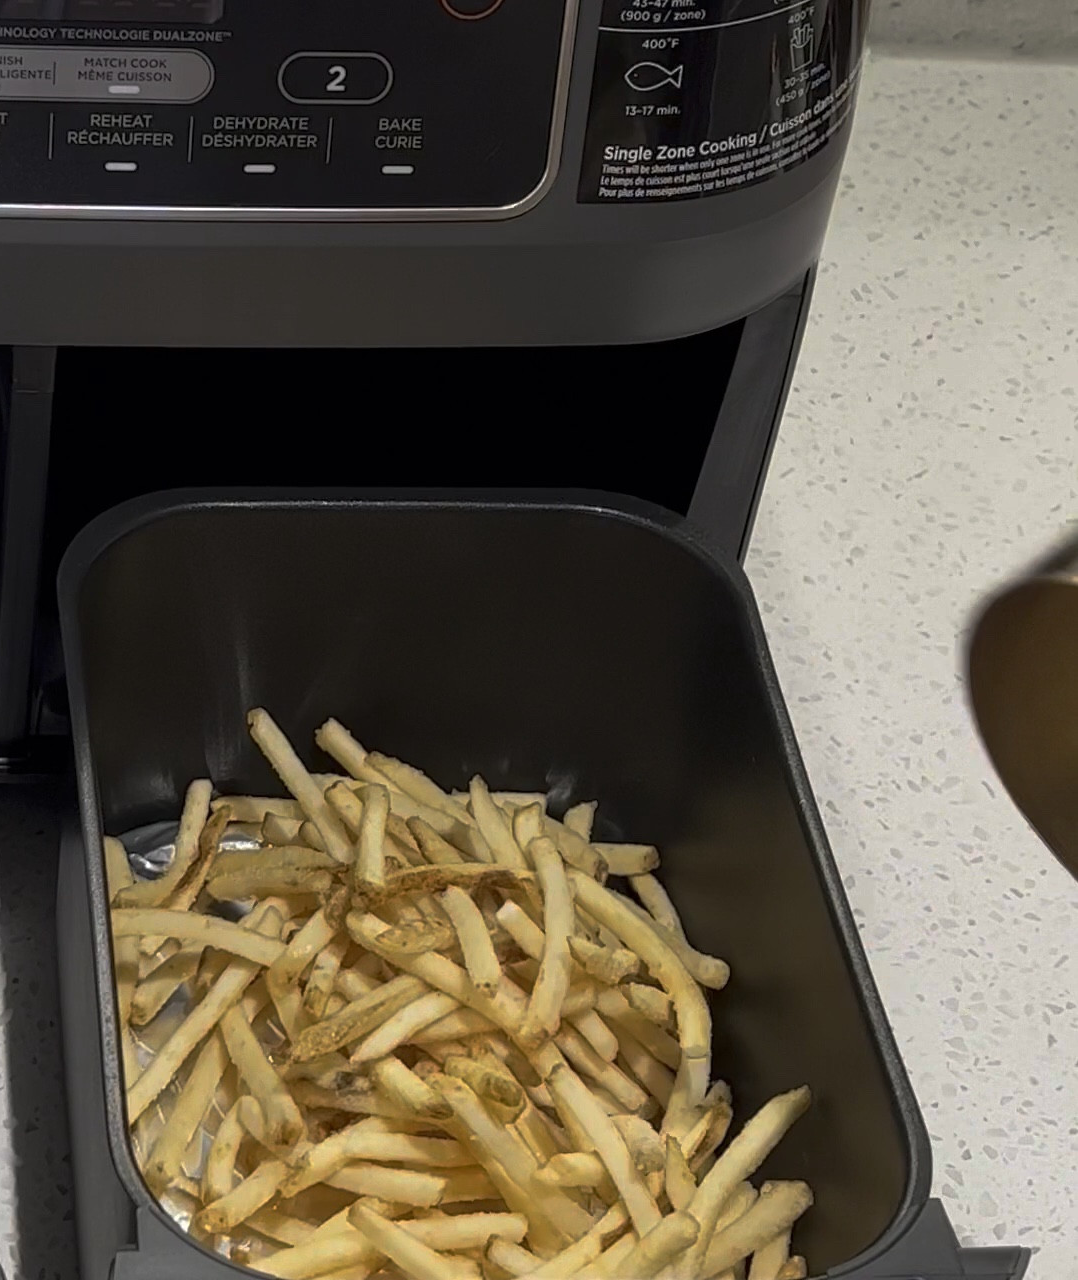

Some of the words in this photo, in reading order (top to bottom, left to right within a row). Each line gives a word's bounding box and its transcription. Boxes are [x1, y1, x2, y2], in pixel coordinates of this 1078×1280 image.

[621, 10, 650, 22] (900
[653, 12, 662, 23] g
[673, 9, 706, 21] zone)
[60, 28, 150, 41] TECHNOLOGIE
[84, 57, 128, 69] MATCH
[130, 58, 167, 69] COOK
[116, 71, 172, 82] CUISSON
[326, 65, 347, 91] 2
[625, 105, 654, 116] 13-17
[657, 104, 681, 116] min.
[90, 114, 152, 127] REHEAT
[214, 117, 308, 130] DEHYDRATE
[379, 118, 422, 131] BAKE
[68, 129, 173, 146] RÉCHAUFFER
[202, 132, 317, 147] DÉSHYDRATER
[375, 136, 422, 148] CURIE
[603, 145, 653, 164] Single
[656, 145, 696, 160] Zone
[699, 132, 757, 155] Cooking
[769, 108, 812, 137] Cuisson
[598, 186, 617, 197] Pour
[617, 187, 634, 199] plus
[634, 187, 645, 197] de
